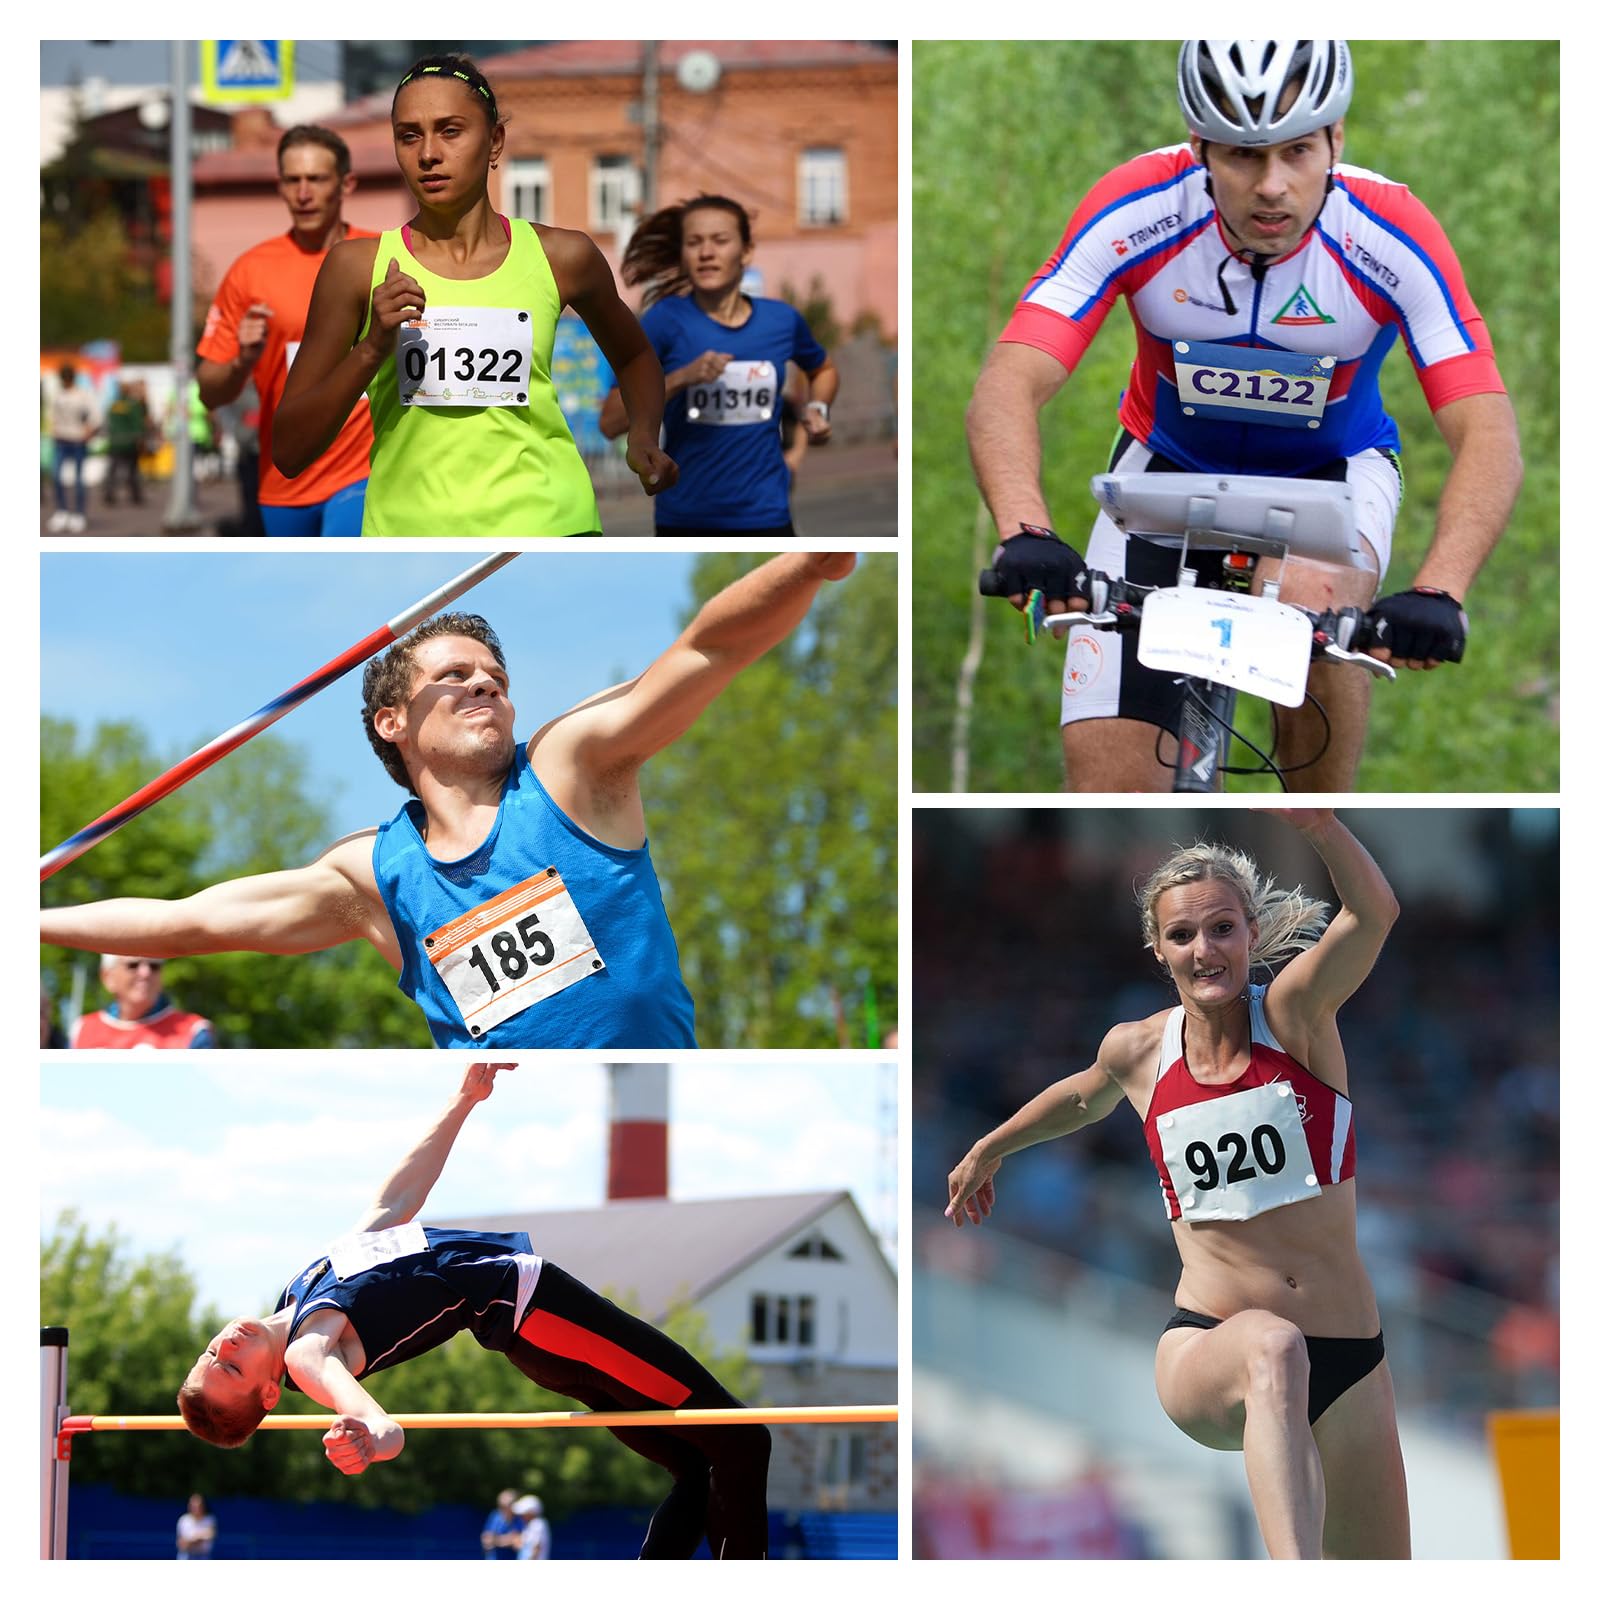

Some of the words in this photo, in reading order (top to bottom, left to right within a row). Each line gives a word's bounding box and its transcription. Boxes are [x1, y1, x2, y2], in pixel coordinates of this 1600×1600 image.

[453, 71, 469, 80] NIKE
[1128, 212, 1184, 247] TRIMTEX
[404, 347, 524, 384] 01322
[693, 387, 770, 411] 01316
[1191, 369, 1315, 406] C2122
[1211, 617, 1233, 649] 1
[468, 913, 556, 994] 185
[1184, 1123, 1287, 1191] 920
